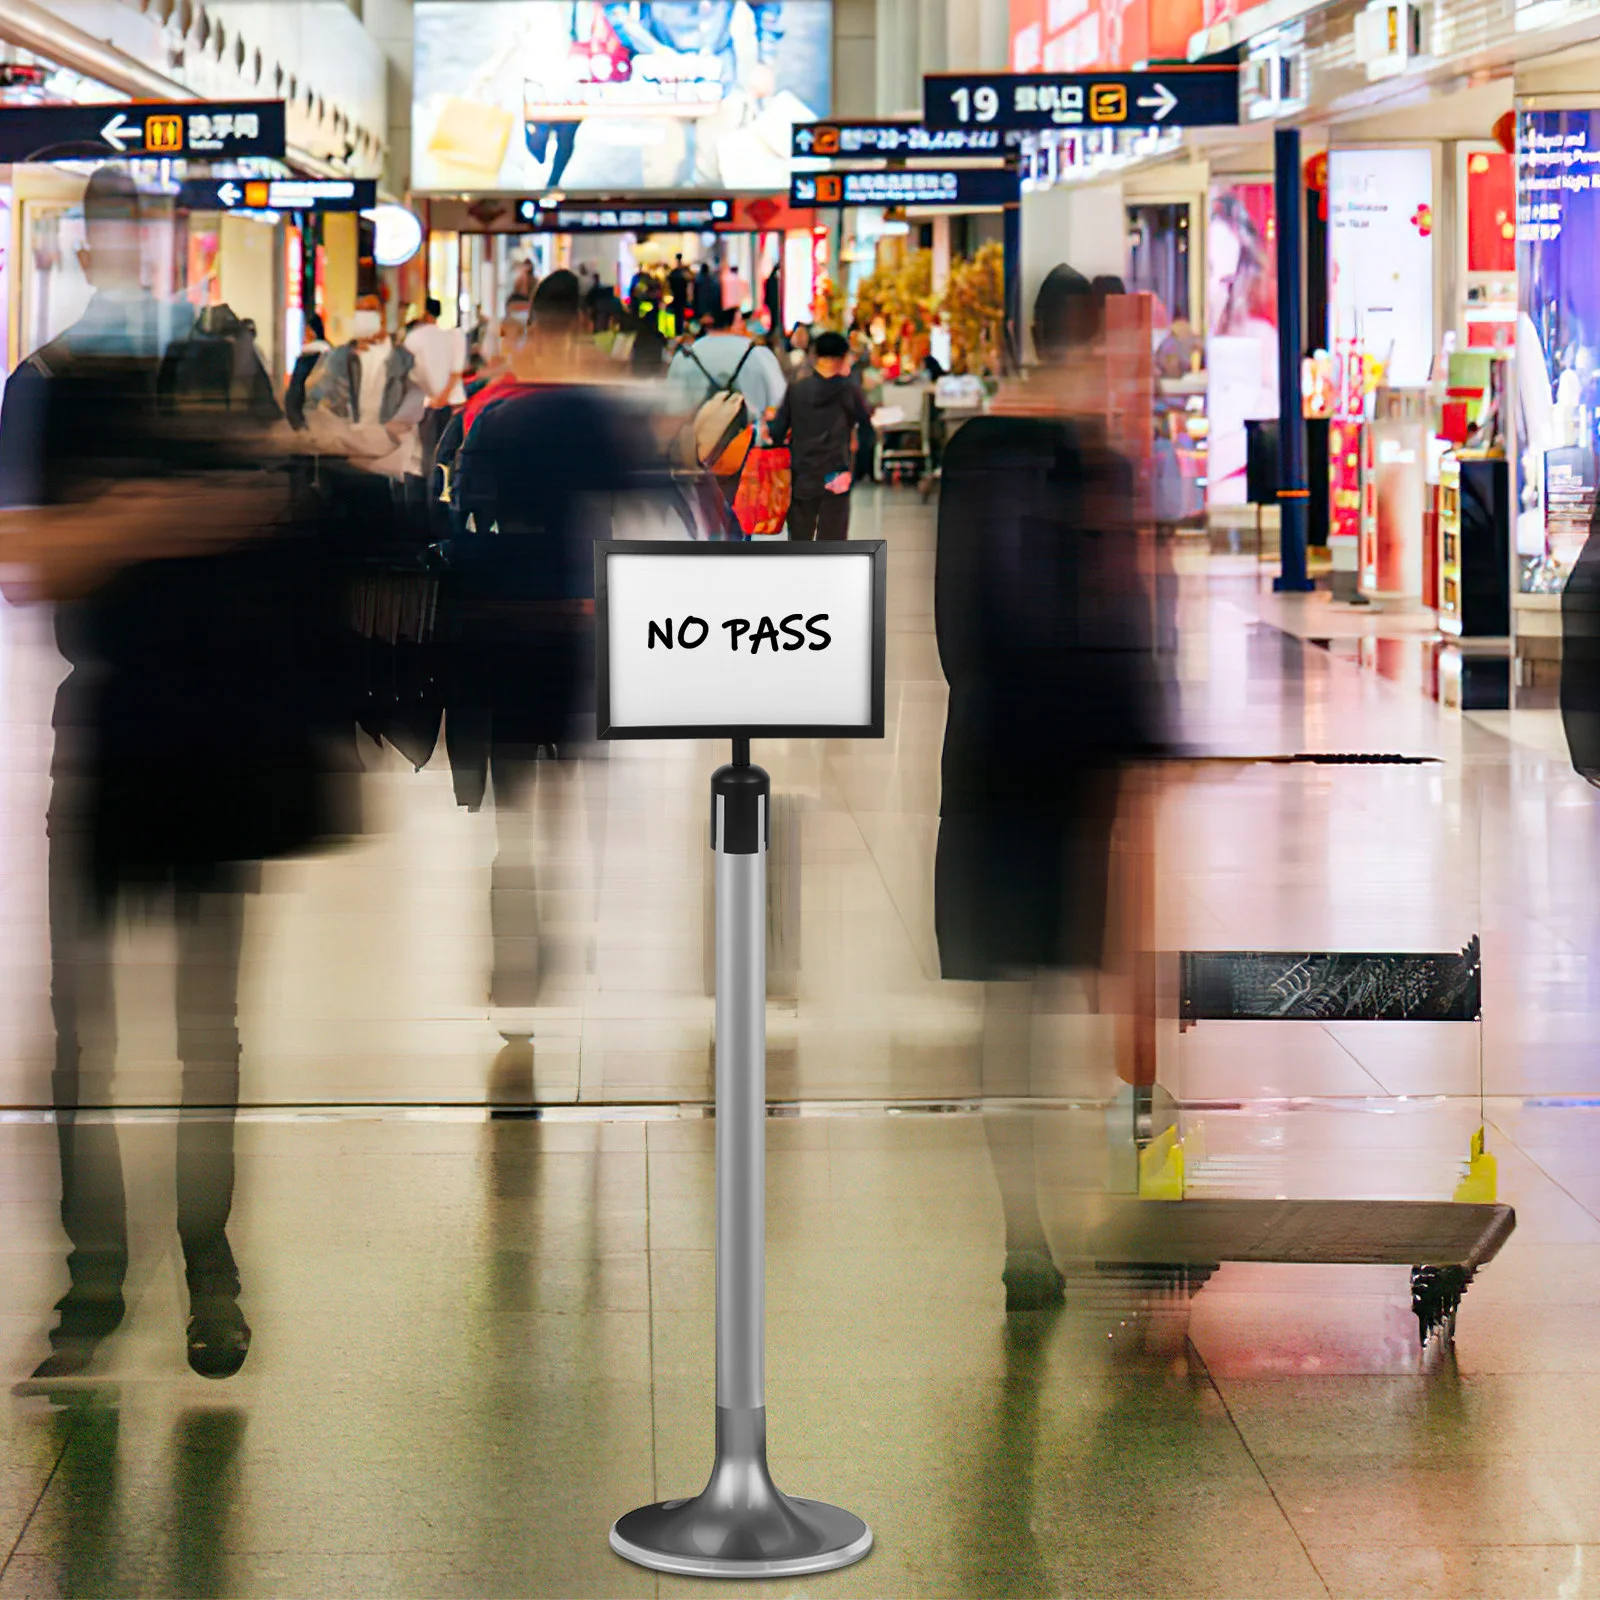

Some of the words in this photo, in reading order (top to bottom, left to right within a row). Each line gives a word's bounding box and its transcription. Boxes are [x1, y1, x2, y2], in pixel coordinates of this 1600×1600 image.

[950, 86, 999, 122] 19
[648, 616, 709, 649] NO
[722, 614, 831, 654] PASS
